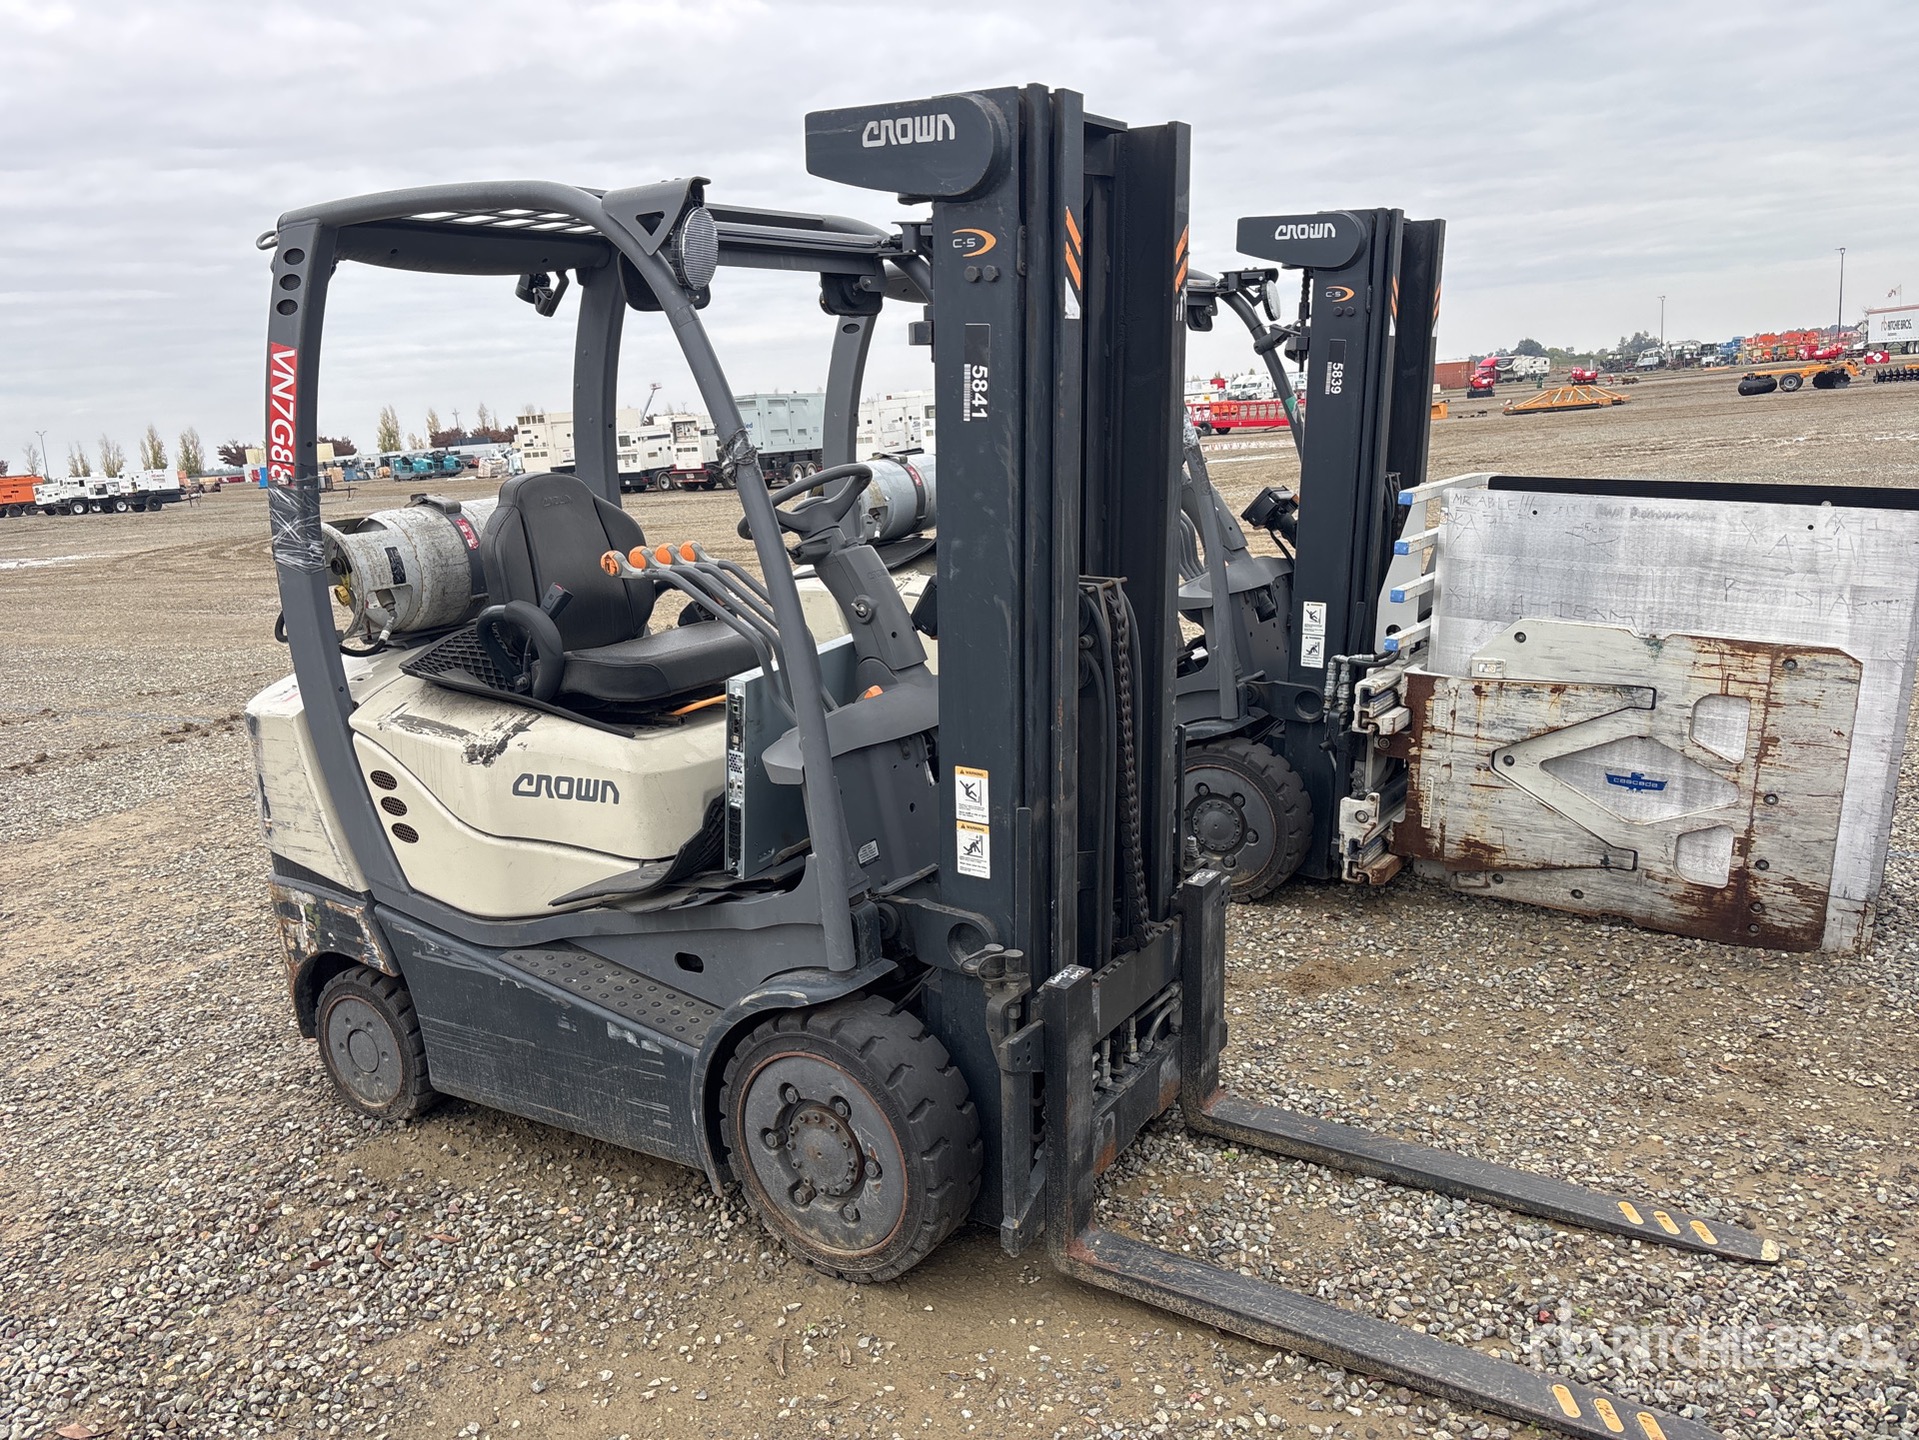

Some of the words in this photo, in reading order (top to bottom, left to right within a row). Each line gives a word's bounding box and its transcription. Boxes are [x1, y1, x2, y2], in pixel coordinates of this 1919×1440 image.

[862, 113, 956, 148] CROWN
[1274, 223, 1336, 240] CROWN
[971, 364, 988, 420] 5841
[1330, 362, 1344, 395] 5839
[512, 773, 620, 805] CROWN
[1613, 777, 1658, 788] cascade
